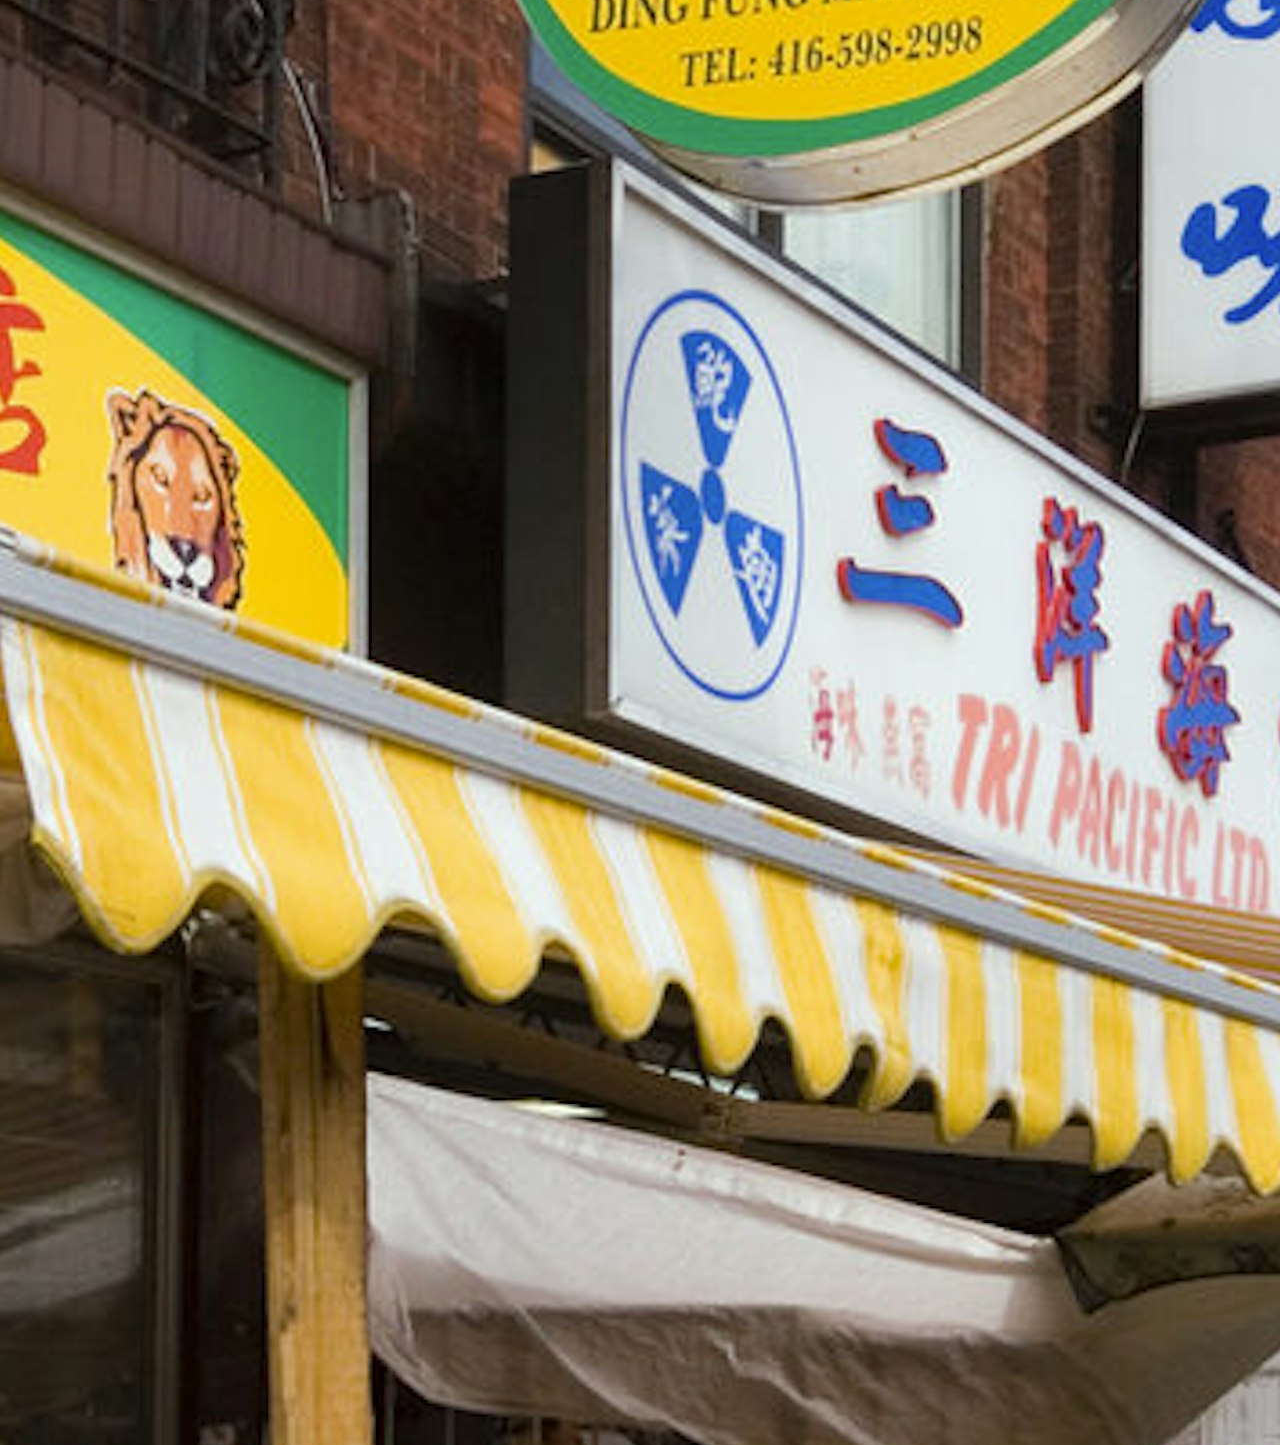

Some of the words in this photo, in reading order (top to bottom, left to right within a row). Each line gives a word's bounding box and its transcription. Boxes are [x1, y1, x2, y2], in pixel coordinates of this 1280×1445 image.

[680, 47, 758, 89] TEL:
[767, 17, 983, 80] 416-598-2998
[950, 693, 1042, 836] TRI
[1048, 739, 1200, 899] PACIFIC
